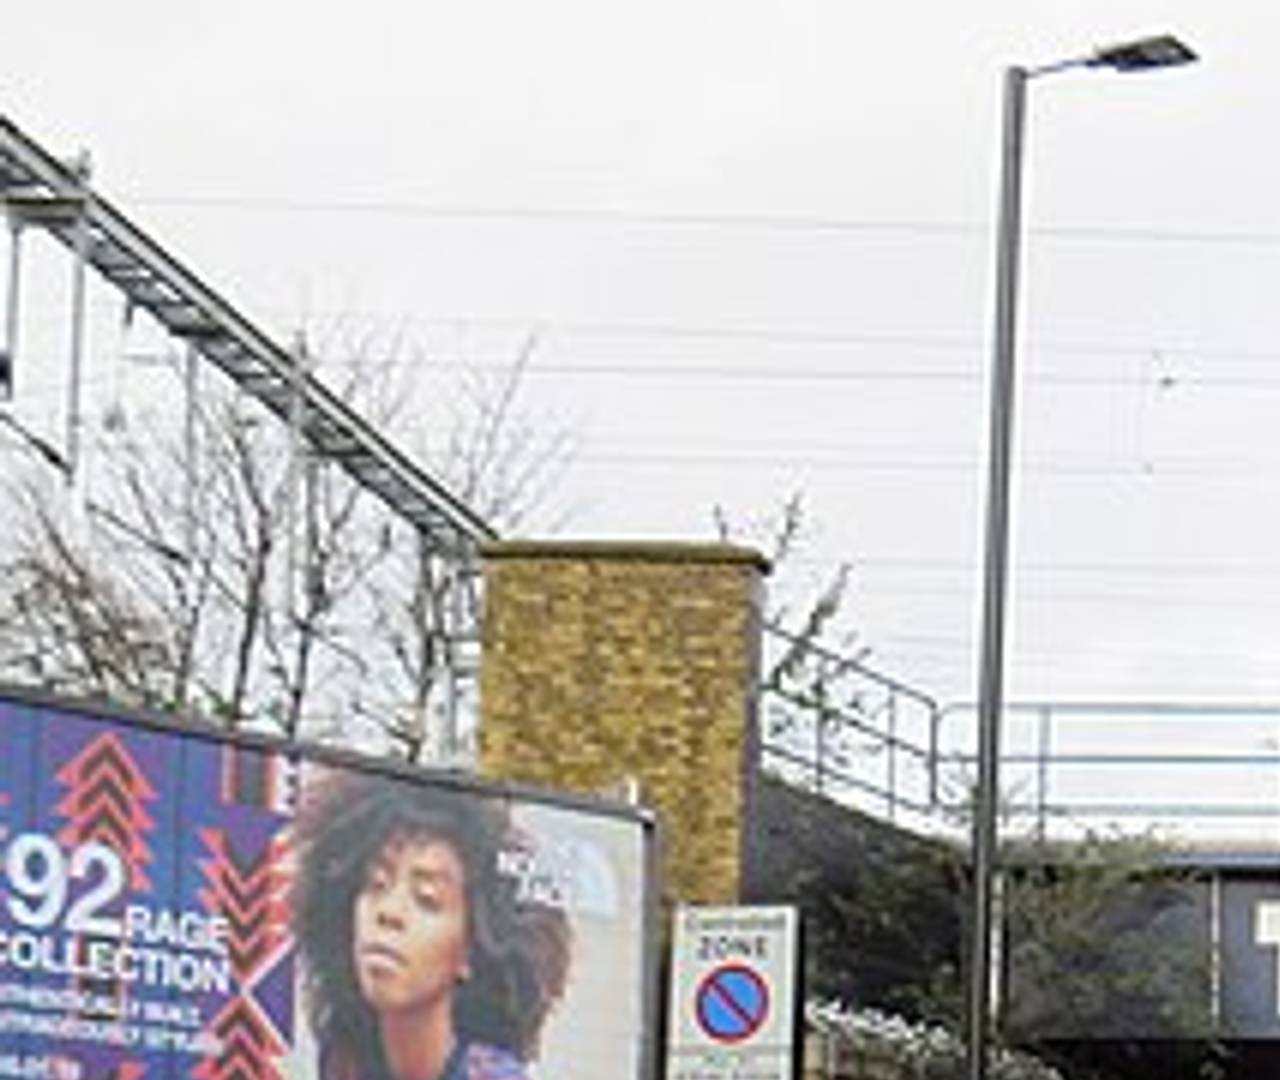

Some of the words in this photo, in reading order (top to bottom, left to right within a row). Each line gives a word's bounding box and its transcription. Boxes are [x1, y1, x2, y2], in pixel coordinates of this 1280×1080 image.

[6, 833, 124, 935] 92
[125, 903, 230, 955] RAGE
[697, 936, 769, 959] ZONE
